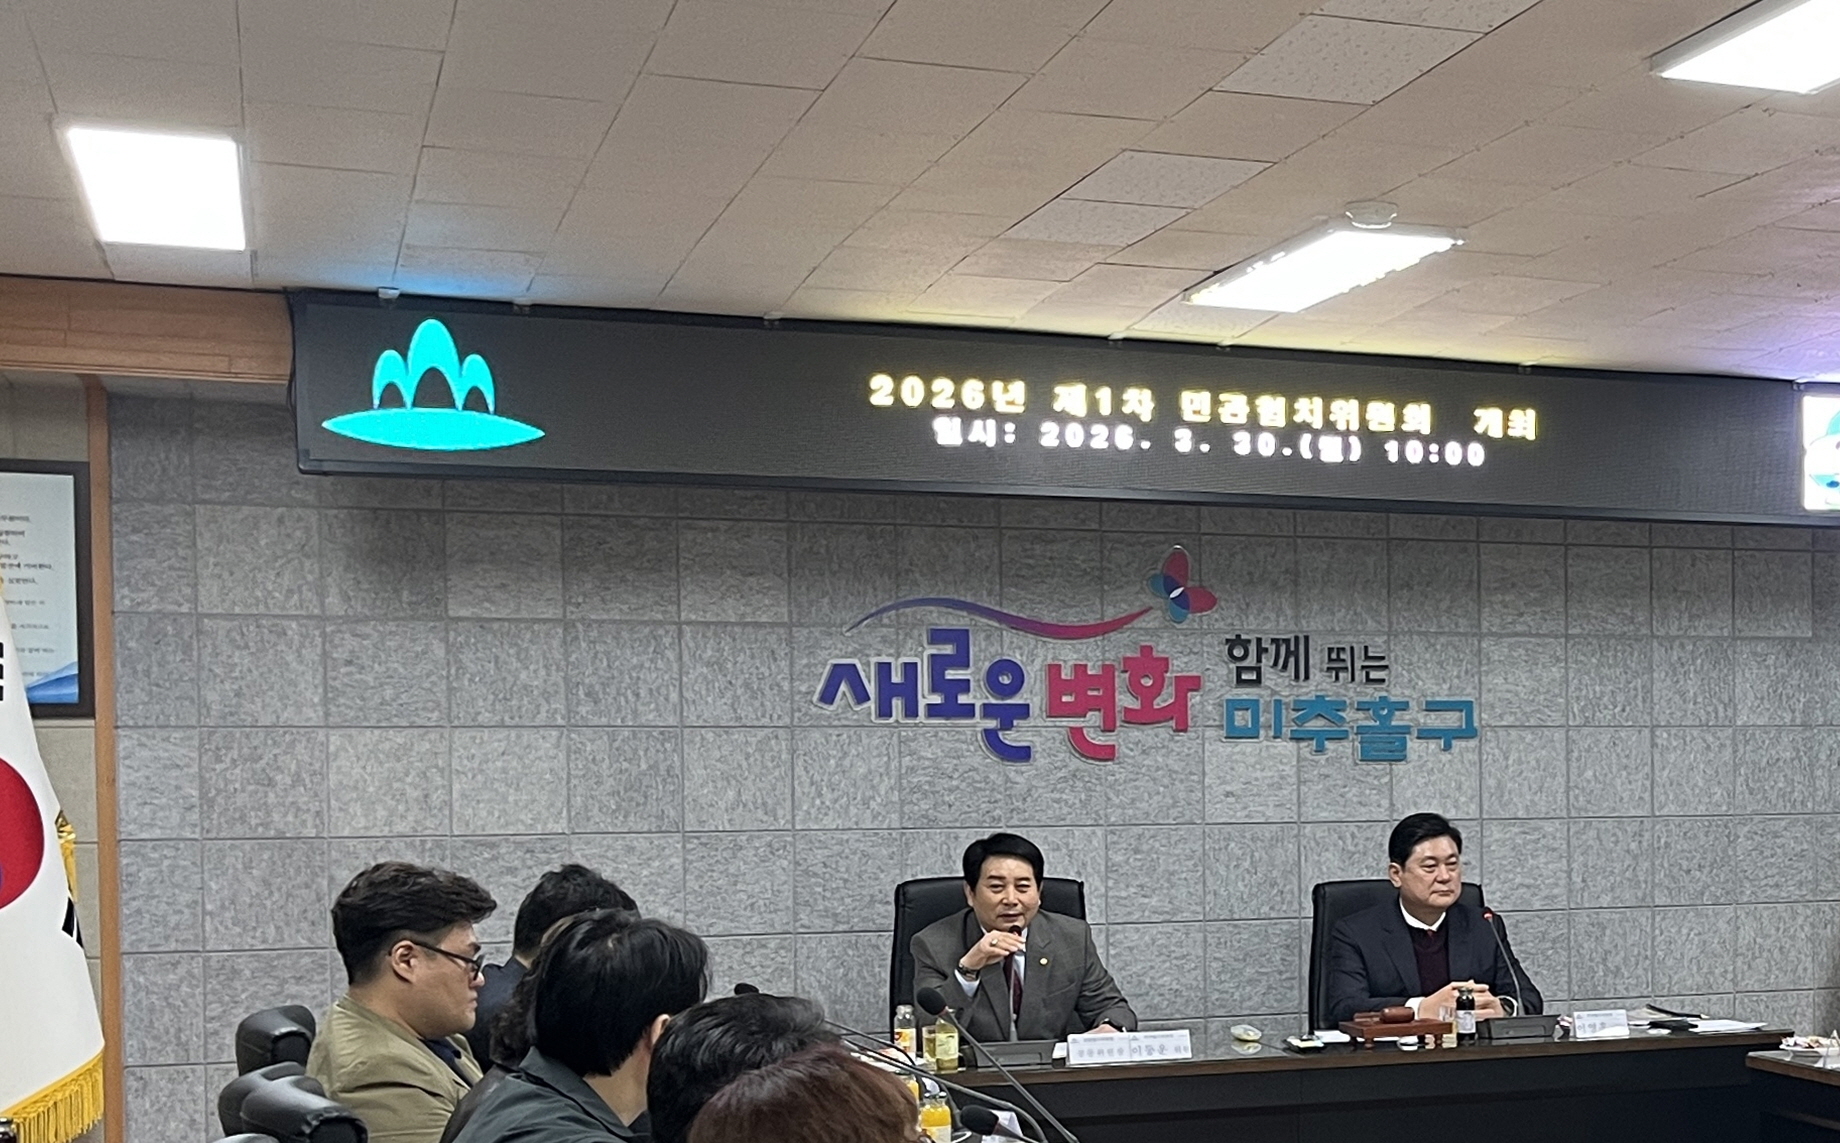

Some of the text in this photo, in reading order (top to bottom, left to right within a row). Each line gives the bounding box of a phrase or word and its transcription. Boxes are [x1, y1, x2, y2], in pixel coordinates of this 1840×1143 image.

[868, 373, 1026, 414] 2026년
[1053, 381, 1154, 423] 제1차
[1041, 423, 1152, 452] 2026.
[1384, 440, 1486, 467] 10:00
[1224, 633, 1391, 686] 함께 뛰는
[815, 627, 1202, 762] 새로운 변화
[1223, 696, 1478, 763] 미추홀구
